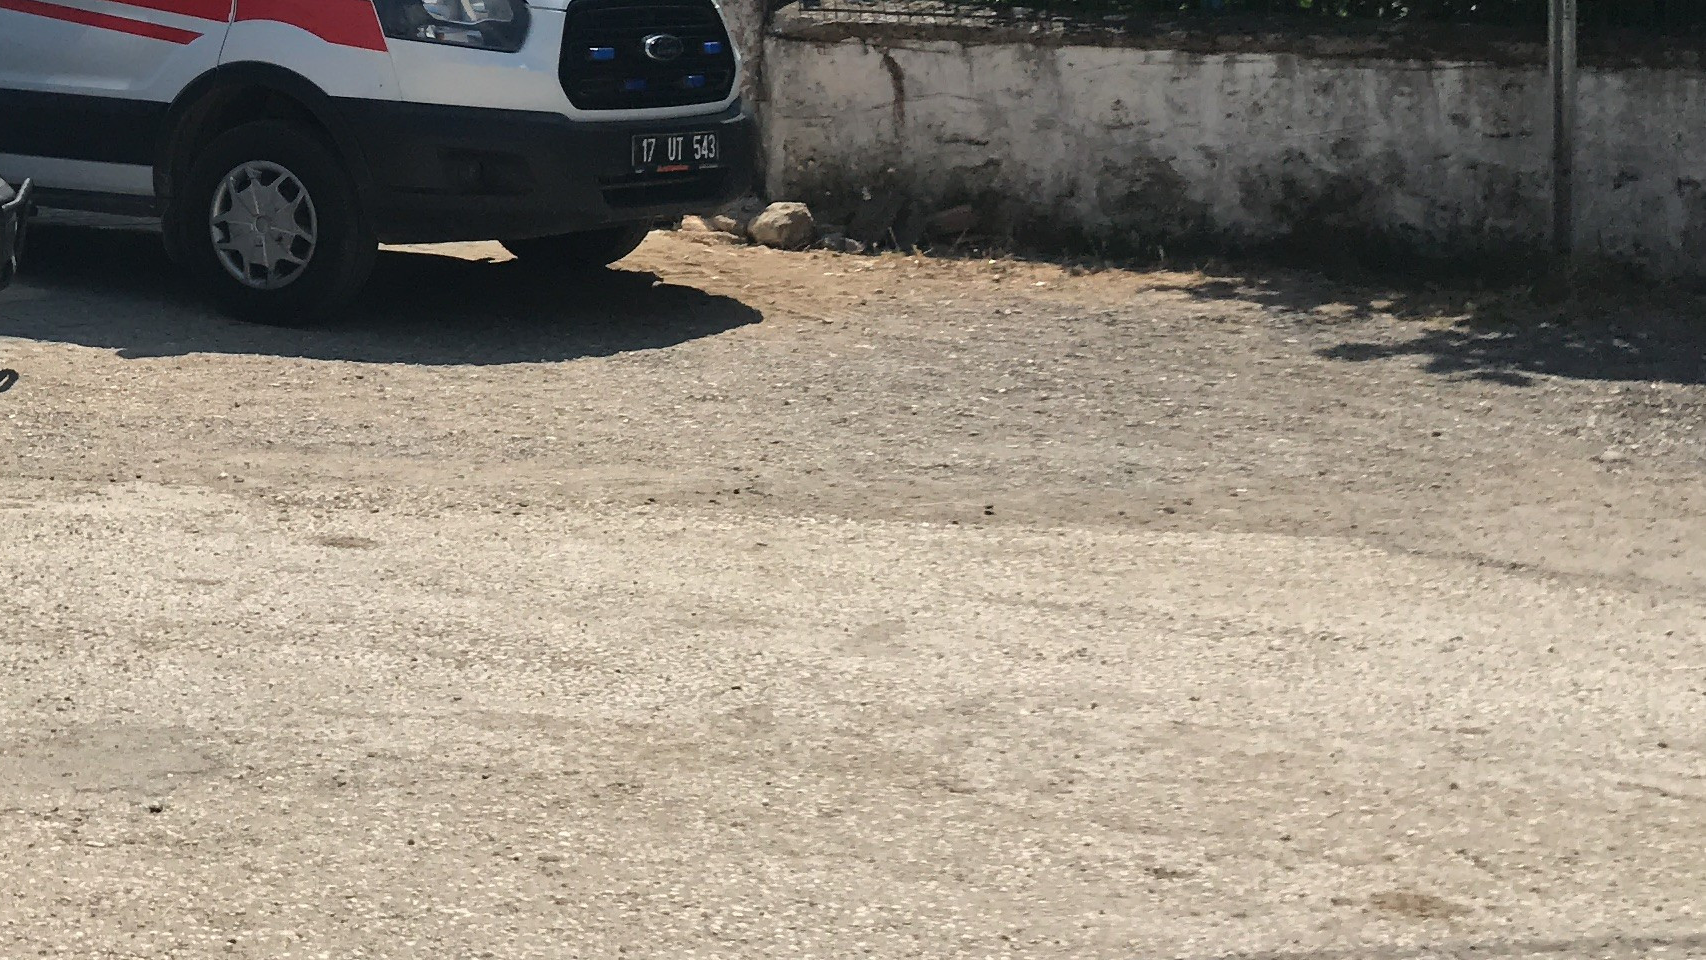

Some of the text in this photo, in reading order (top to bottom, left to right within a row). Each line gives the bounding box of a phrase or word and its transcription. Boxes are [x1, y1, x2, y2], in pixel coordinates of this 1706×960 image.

[642, 134, 716, 162] 17 UT 543
